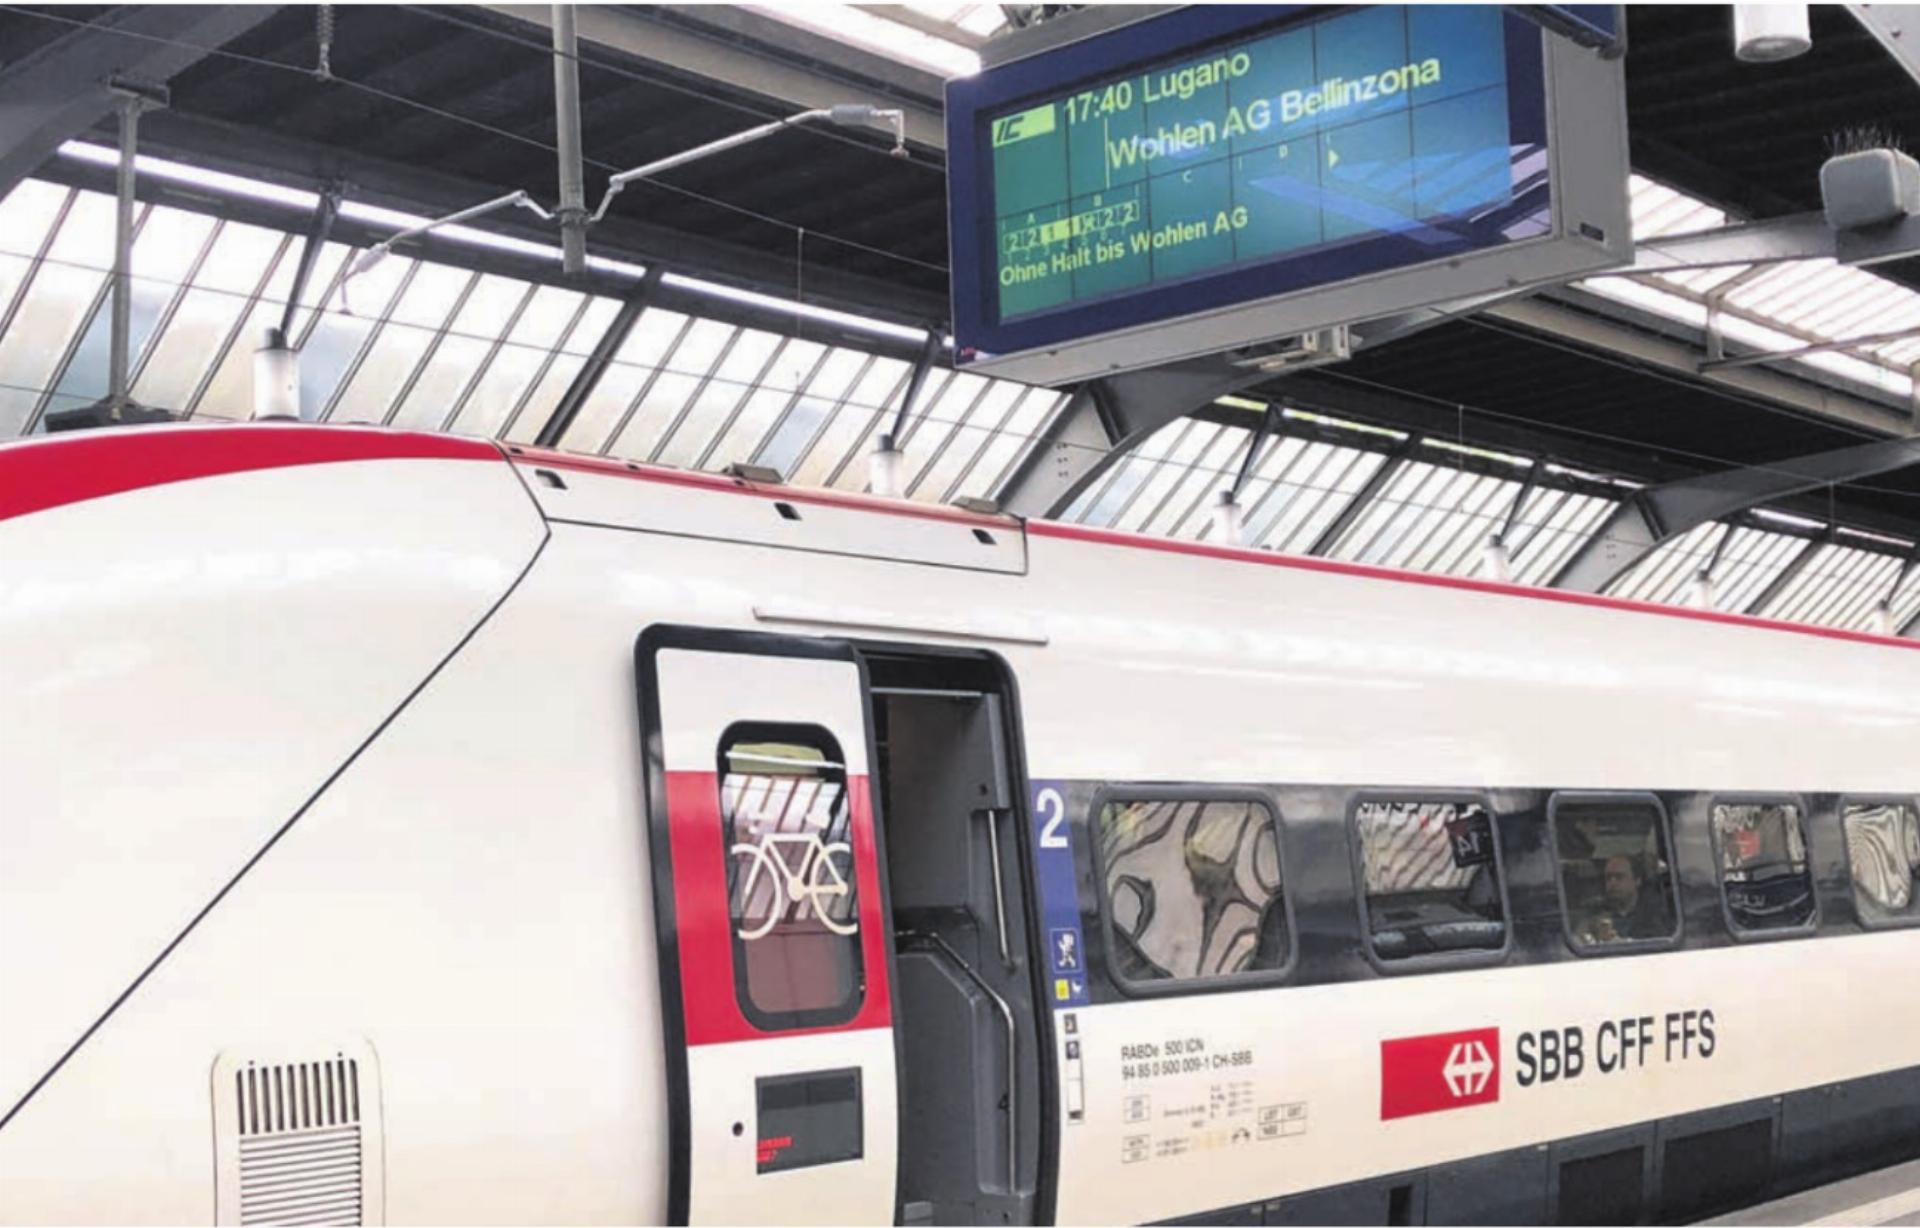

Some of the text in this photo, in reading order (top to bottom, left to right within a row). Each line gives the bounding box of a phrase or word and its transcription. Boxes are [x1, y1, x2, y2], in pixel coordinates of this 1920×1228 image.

[1064, 81, 1132, 125] 17:40
[1143, 52, 1250, 102] Lugano
[1107, 57, 1440, 169] Wohlen AG Bellinzona
[1000, 260, 1048, 286] Ohne
[1052, 247, 1090, 274] Halt
[1096, 240, 1125, 263] bis
[1130, 221, 1207, 255] Wohlen
[1213, 206, 1249, 234] AG
[1037, 788, 1067, 848] 2
[1122, 1064, 1135, 1080] 94
[1162, 1059, 1180, 1075] 500
[1212, 1050, 1253, 1069] CH-SBB
[1165, 1039, 1183, 1056] 500
[1516, 1009, 1716, 1087] SBB CFF FFS
